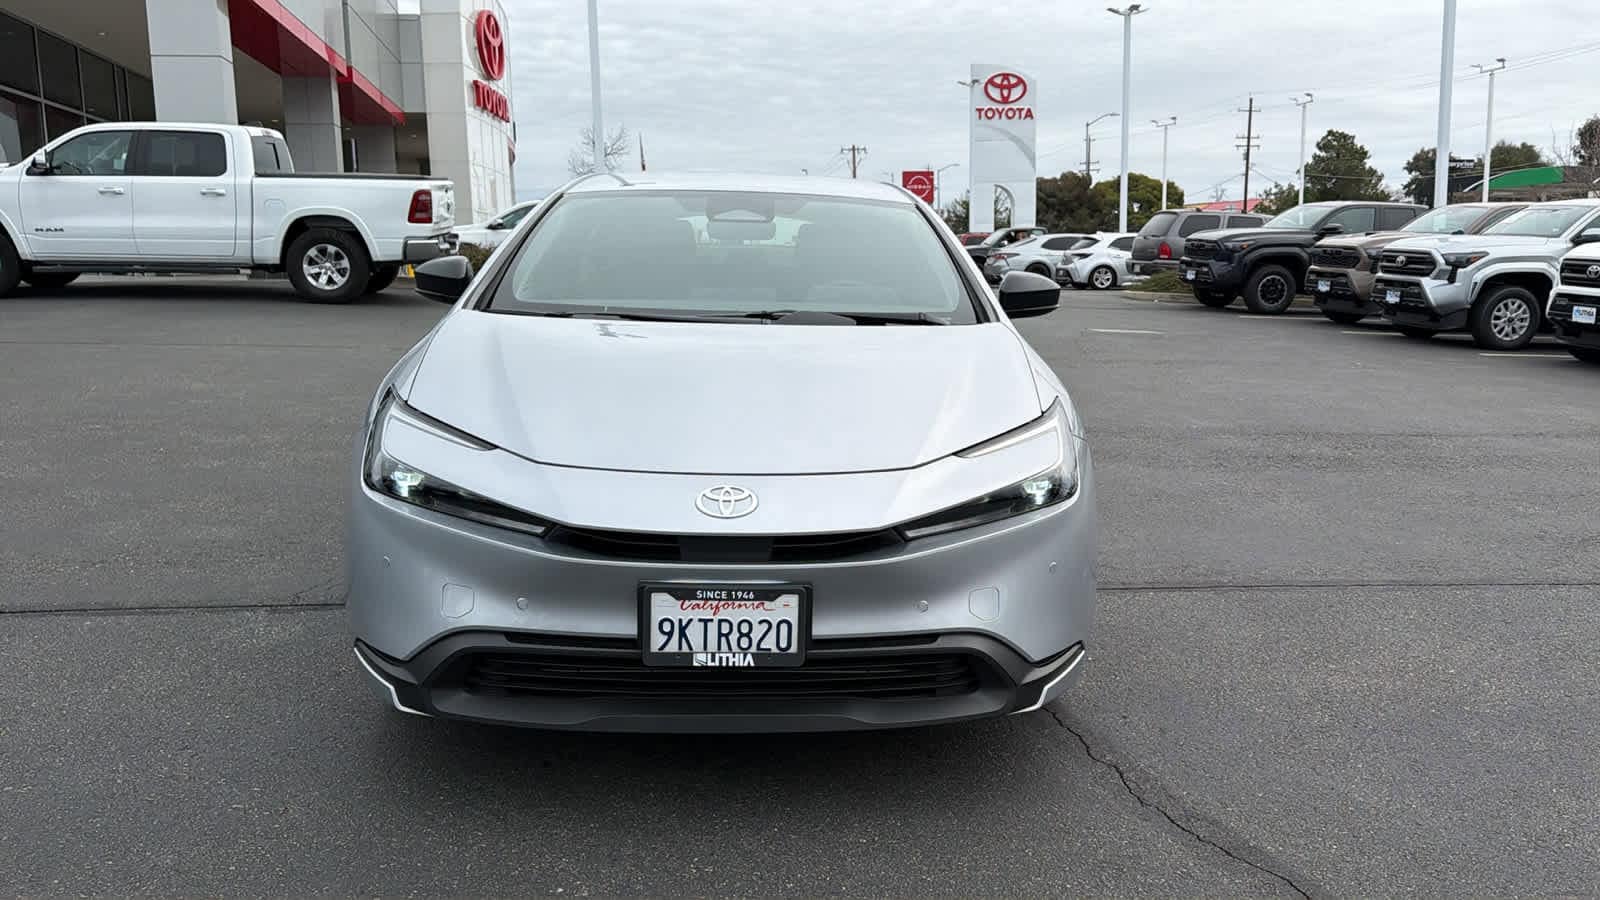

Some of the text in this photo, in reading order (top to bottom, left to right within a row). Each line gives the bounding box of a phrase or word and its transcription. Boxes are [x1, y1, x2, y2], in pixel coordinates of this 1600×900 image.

[473, 79, 510, 123] TOYOTA
[975, 107, 1034, 120] TOYOTA
[696, 590, 755, 599] SINCE 1946
[679, 600, 776, 616] California
[657, 617, 793, 652] 9KTR820
[708, 653, 755, 666] LITHIA
